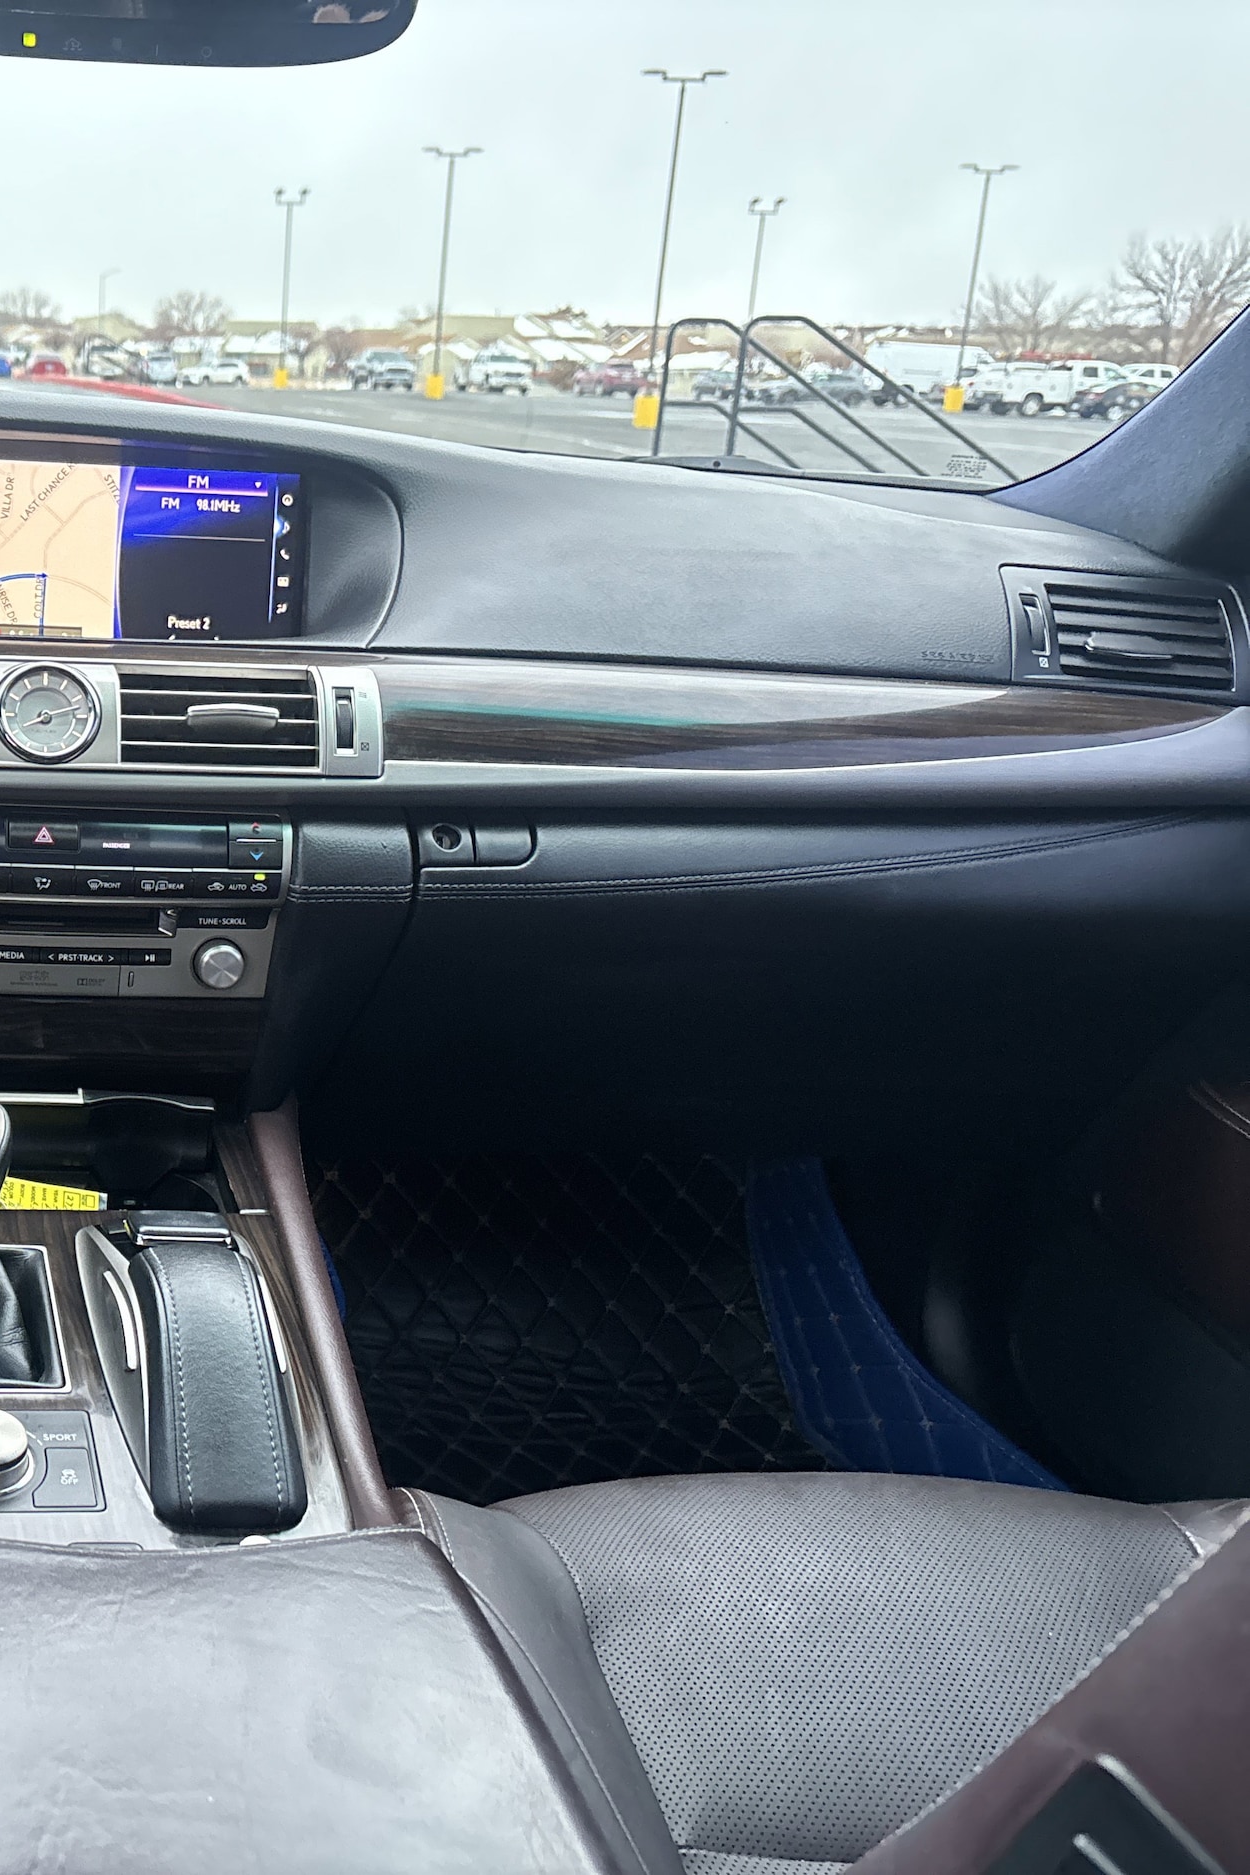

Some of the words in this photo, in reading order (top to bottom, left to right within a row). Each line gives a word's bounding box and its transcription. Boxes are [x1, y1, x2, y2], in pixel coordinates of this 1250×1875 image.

[5, 476, 15, 491] DR
[188, 475, 210, 489] FM
[20, 499, 40, 522] LAST
[37, 467, 70, 501] CHANCE
[0, 492, 13, 520] VILLA
[161, 497, 180, 509] FM
[196, 498, 241, 513] 98.1MHz
[167, 616, 201, 630] Preset
[202, 617, 211, 630] 2
[100, 882, 121, 890] FRONT
[168, 883, 185, 891] REAR
[228, 884, 247, 892] AUTO
[42, 1433, 78, 1442] SPORT
